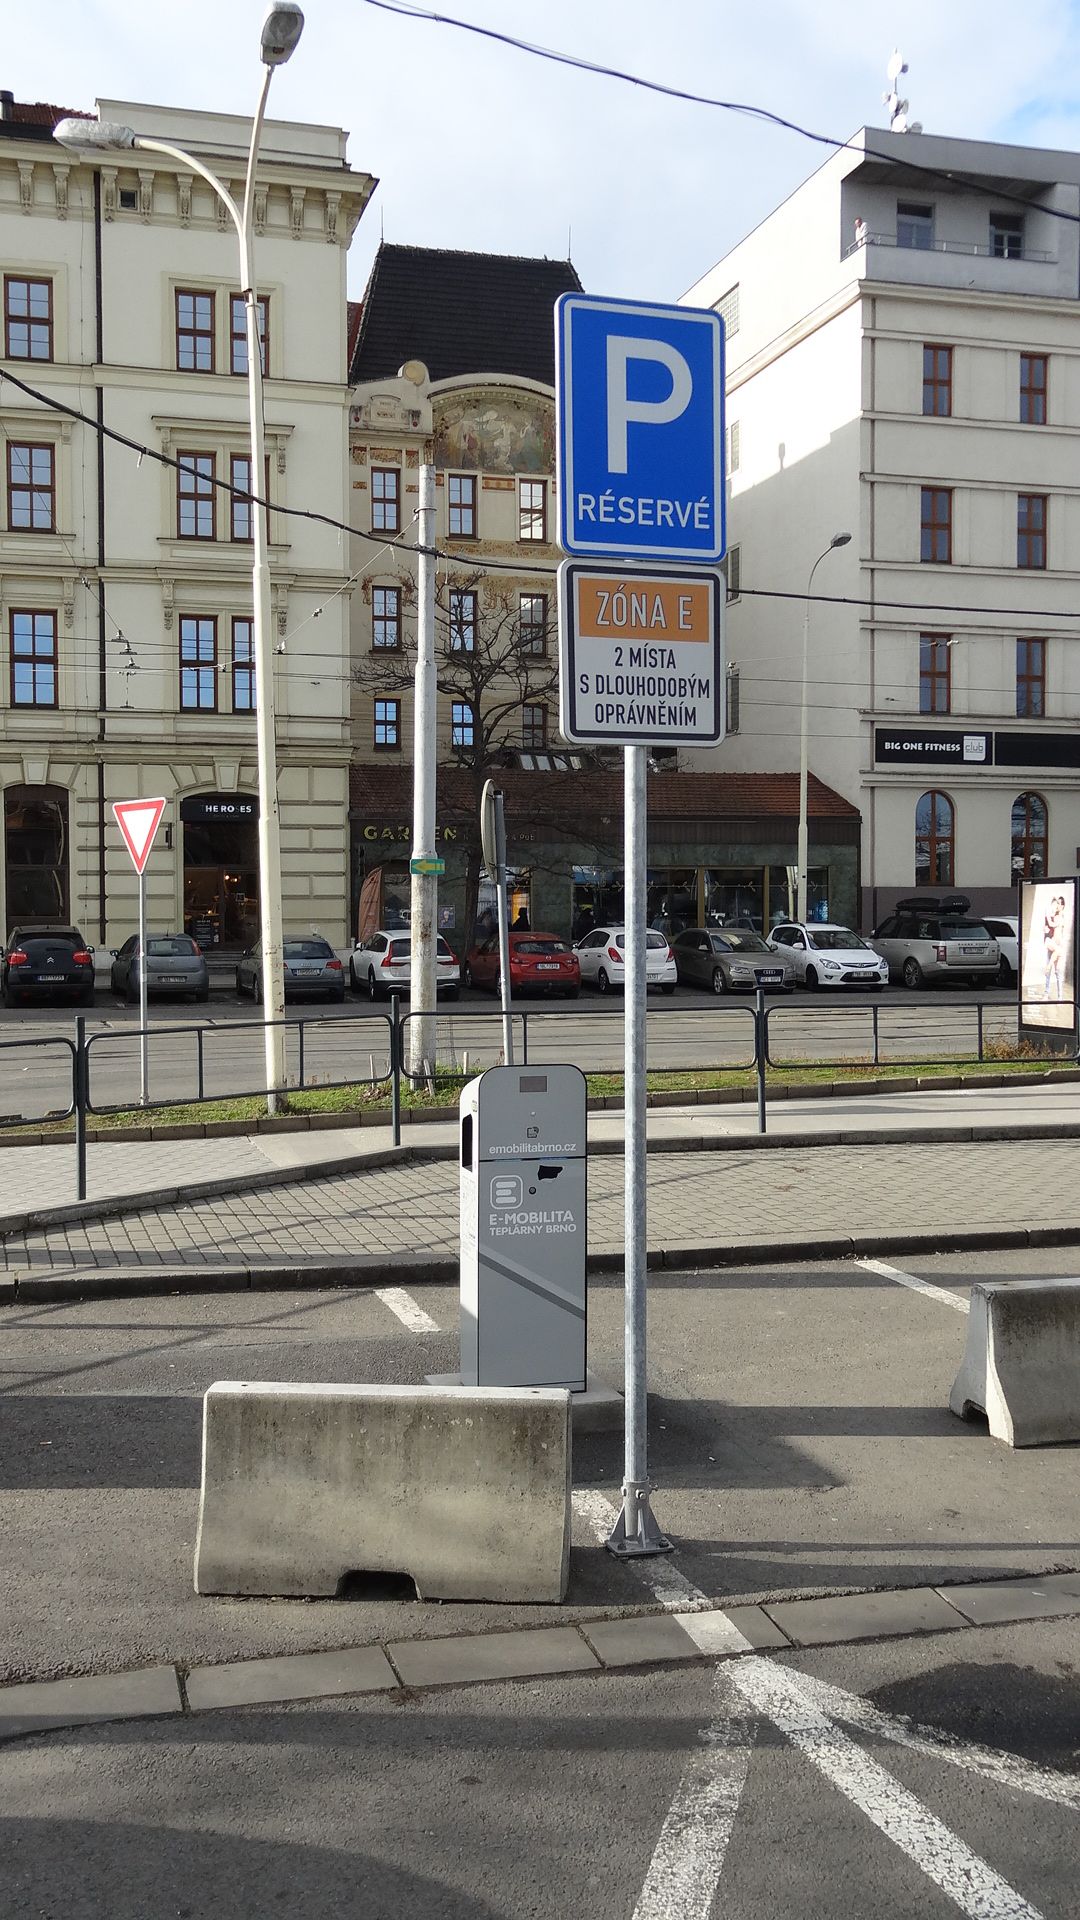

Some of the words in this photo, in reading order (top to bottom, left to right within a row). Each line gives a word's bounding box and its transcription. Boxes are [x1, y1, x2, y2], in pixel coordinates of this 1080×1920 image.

[606, 334, 694, 475] P
[578, 488, 711, 530] RÉSERVÉ
[596, 583, 668, 630] ZÓNA
[678, 595, 693, 631] E
[614, 646, 624, 667] 2
[629, 642, 677, 670] MÍSTA
[579, 673, 590, 694] S
[595, 673, 710, 699] DLOUHODOBÝM
[594, 699, 697, 727] OPRÁVNĚNÍM
[884, 741, 901, 751] BIG
[902, 742, 923, 751] ONE
[924, 742, 961, 752] FITNESS
[965, 740, 984, 752] club
[489, 1143, 577, 1154] emobilitabrno.cz
[489, 1211, 574, 1225] E-MOBILITA
[489, 1225, 543, 1236] TEPLÁRNY
[545, 1223, 577, 1234] BRNO
